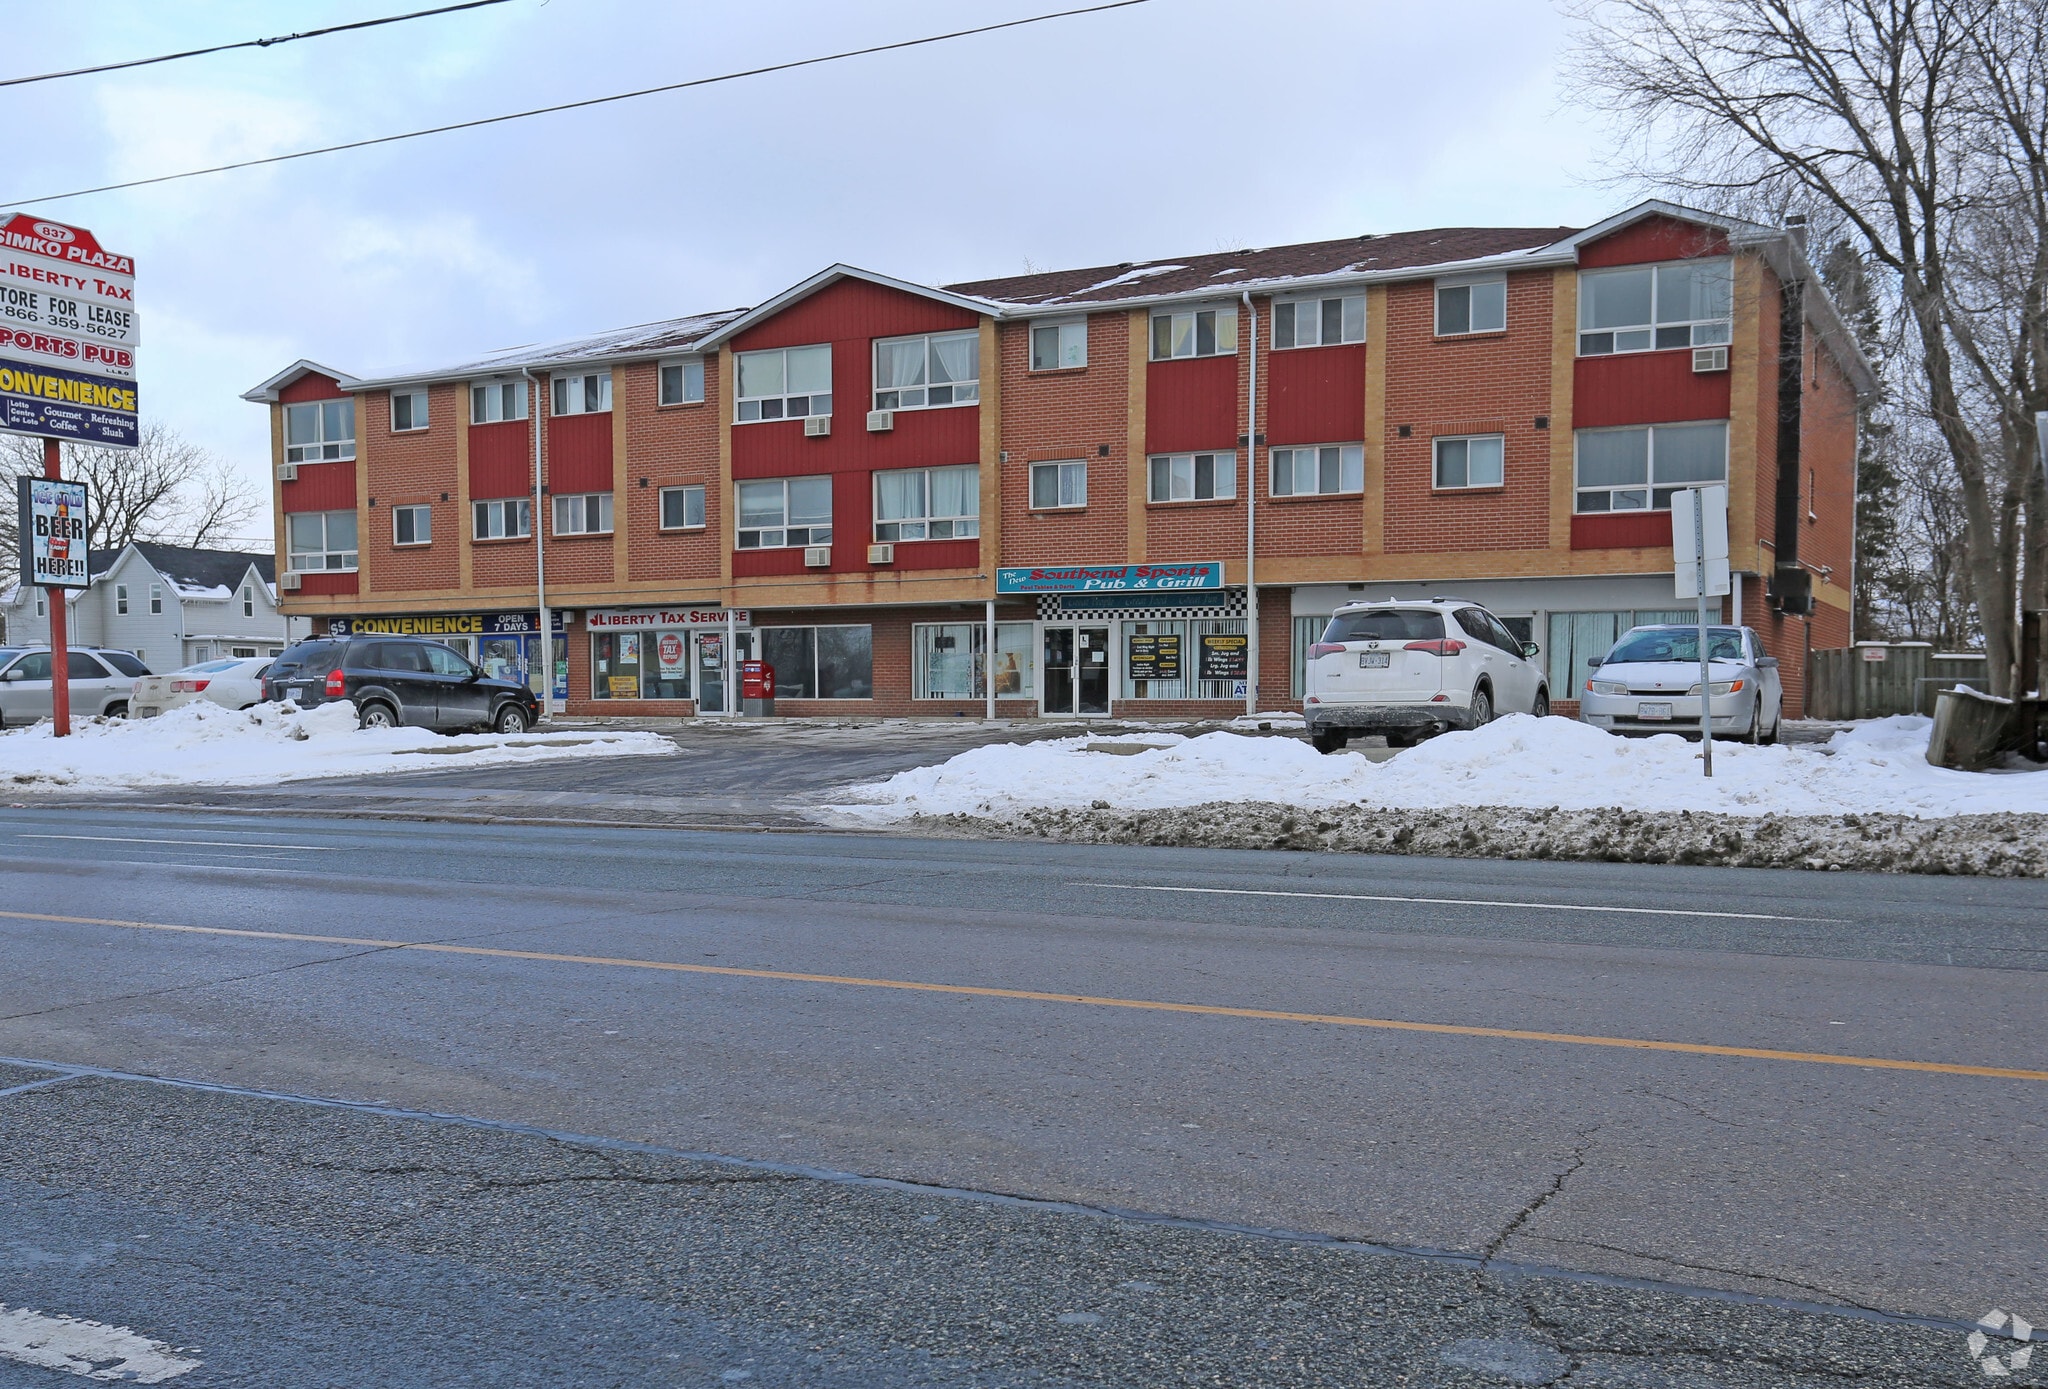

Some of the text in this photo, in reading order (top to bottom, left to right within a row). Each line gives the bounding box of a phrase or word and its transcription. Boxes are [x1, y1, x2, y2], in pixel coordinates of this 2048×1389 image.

[42, 227, 66, 240] 837
[0, 229, 131, 273] SIMKO PLAZA
[0, 262, 87, 290] IBERTY
[0, 287, 130, 328] TORE FOR LEASE
[0, 327, 133, 368] PORTS PUB
[0, 367, 136, 411] ONVENIENCE
[44, 406, 135, 430] Gourmet Refreshing
[50, 419, 124, 438] Coffee Slush
[34, 490, 83, 508] ICE COLD
[36, 514, 83, 540] BEER
[37, 557, 84, 577] HERE!!
[1003, 572, 1017, 580] The
[1029, 566, 1210, 581] Southend Sports
[1083, 576, 1206, 590] Pub & Grill
[351, 616, 483, 634] CONVENIENCE
[498, 614, 524, 623] OPEN
[599, 609, 747, 625] LIBERTY TAX SERVIE
[494, 624, 501, 632] 7
[503, 622, 529, 632] DAYS
[663, 645, 677, 654] TAX
